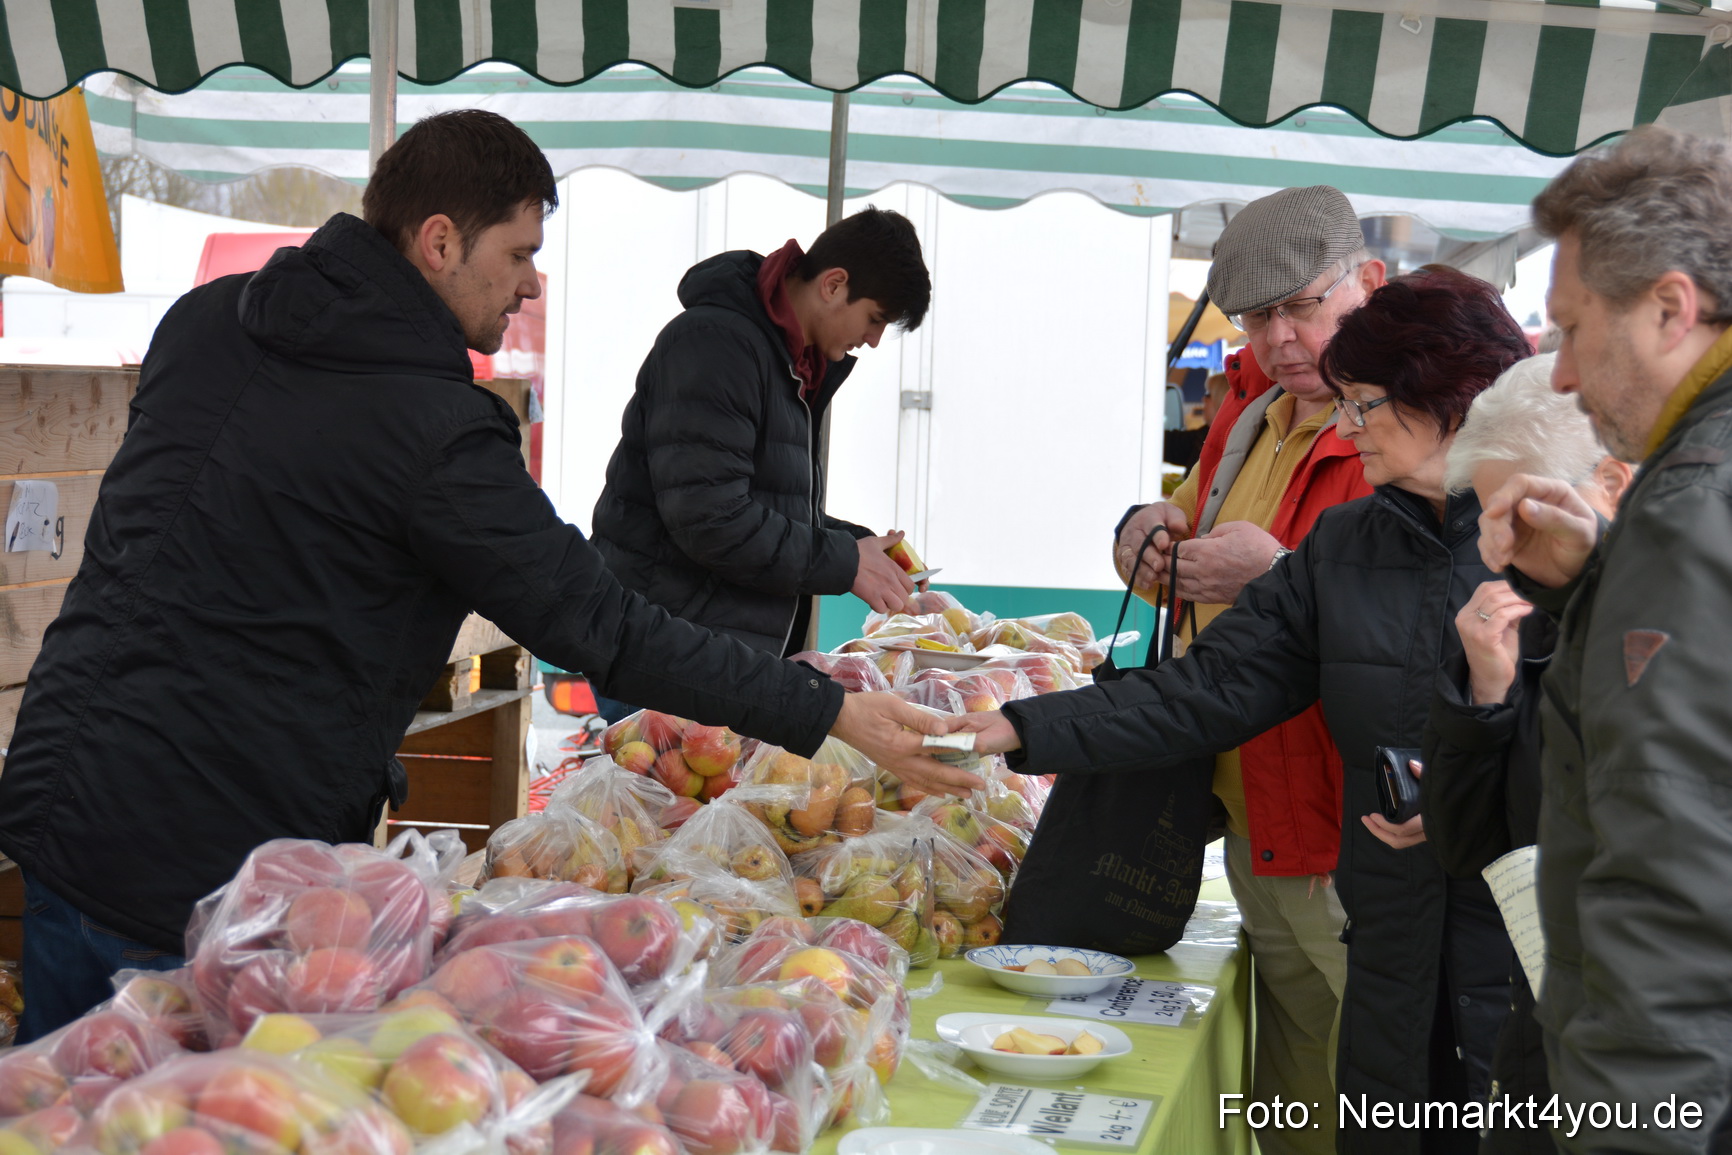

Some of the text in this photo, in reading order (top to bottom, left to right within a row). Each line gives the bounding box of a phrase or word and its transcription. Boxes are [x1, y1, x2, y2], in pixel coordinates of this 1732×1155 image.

[1089, 852, 1195, 909] Markt-Apo
[1099, 978, 1145, 1017] Conference
[988, 1086, 1025, 1109] SORTE
[1027, 1092, 1086, 1134] Wellant
